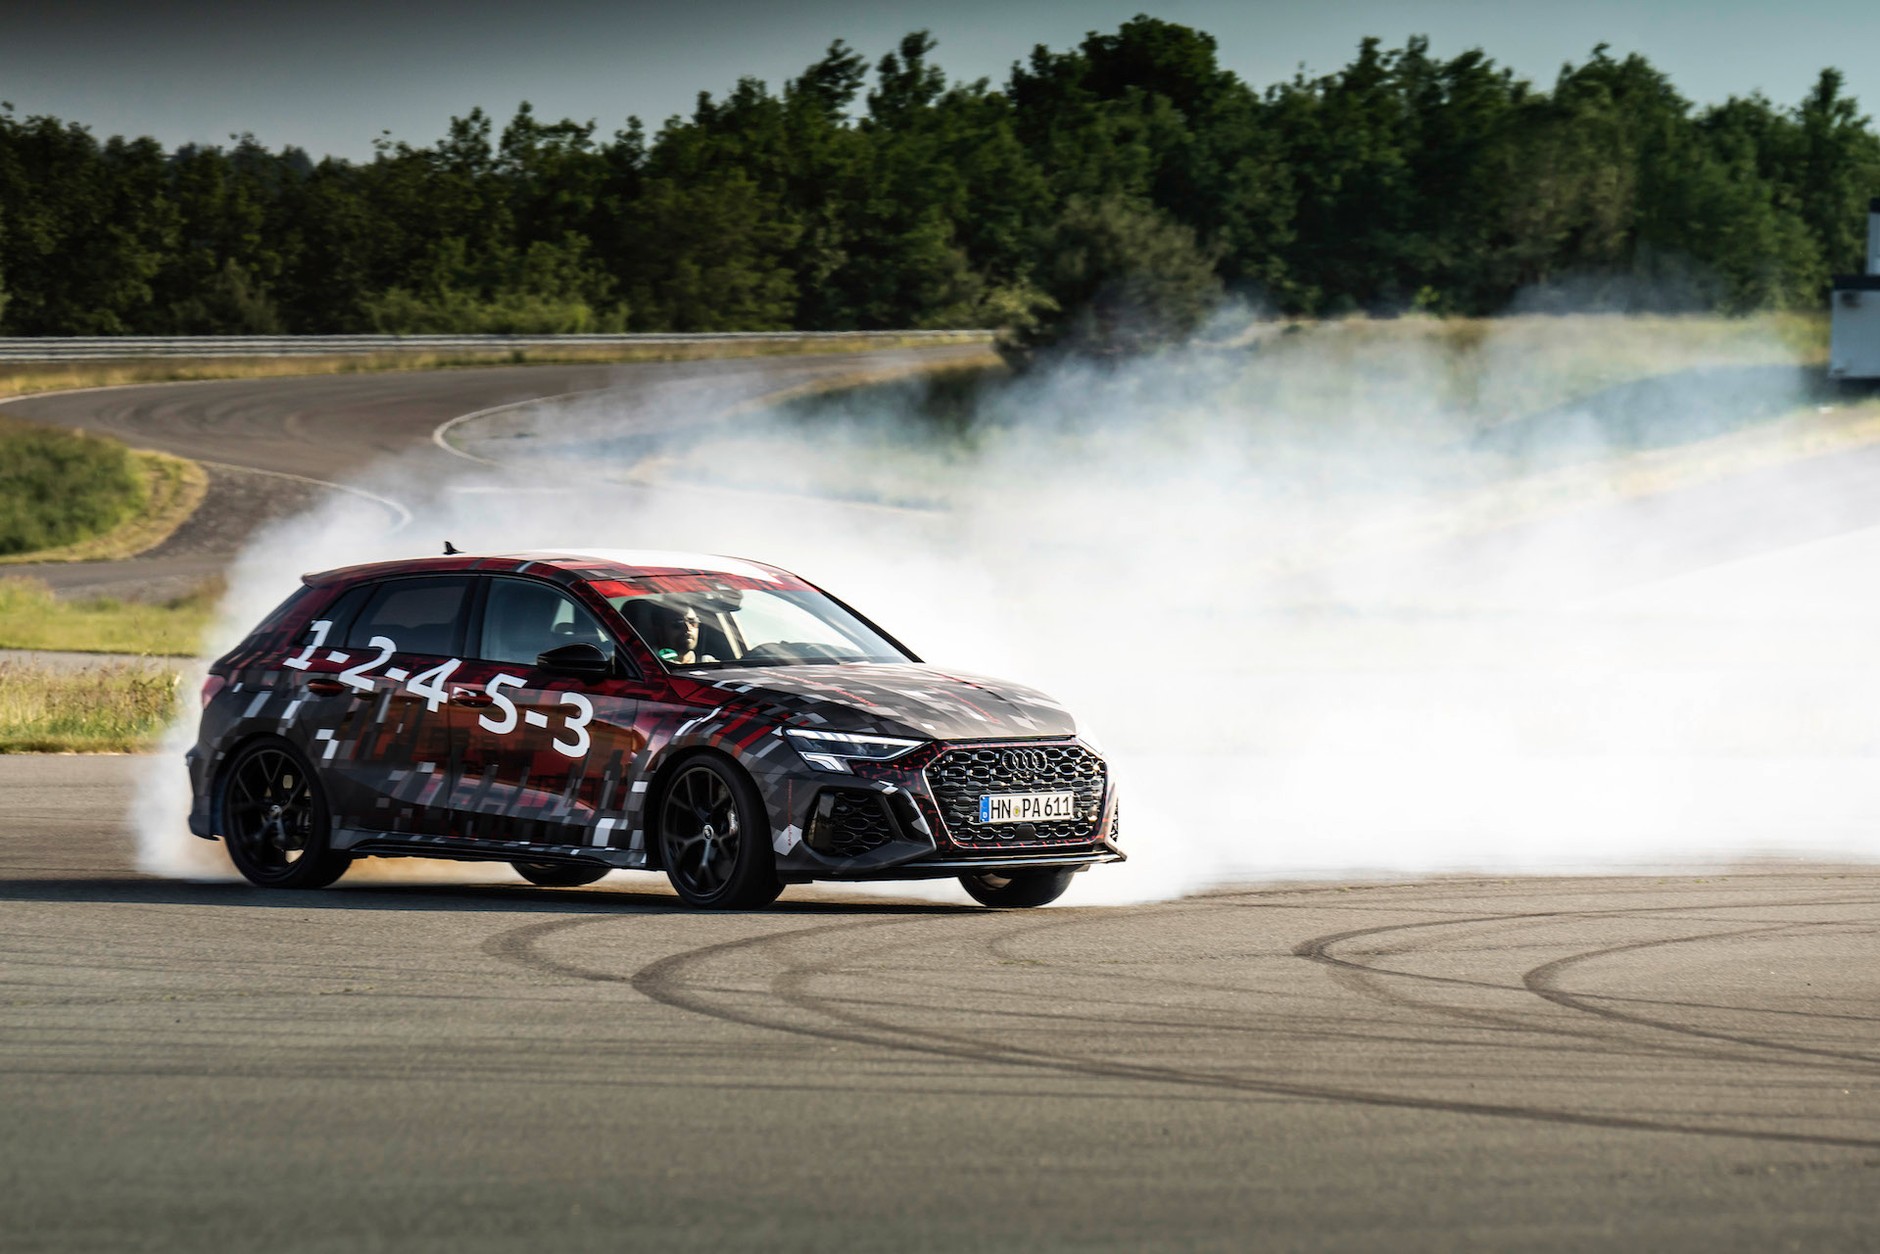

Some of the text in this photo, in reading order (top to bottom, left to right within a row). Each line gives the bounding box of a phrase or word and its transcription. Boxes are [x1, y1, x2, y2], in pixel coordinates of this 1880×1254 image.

[283, 619, 594, 758] 1-2-4-5-3
[991, 797, 1071, 819] HN PA 611
